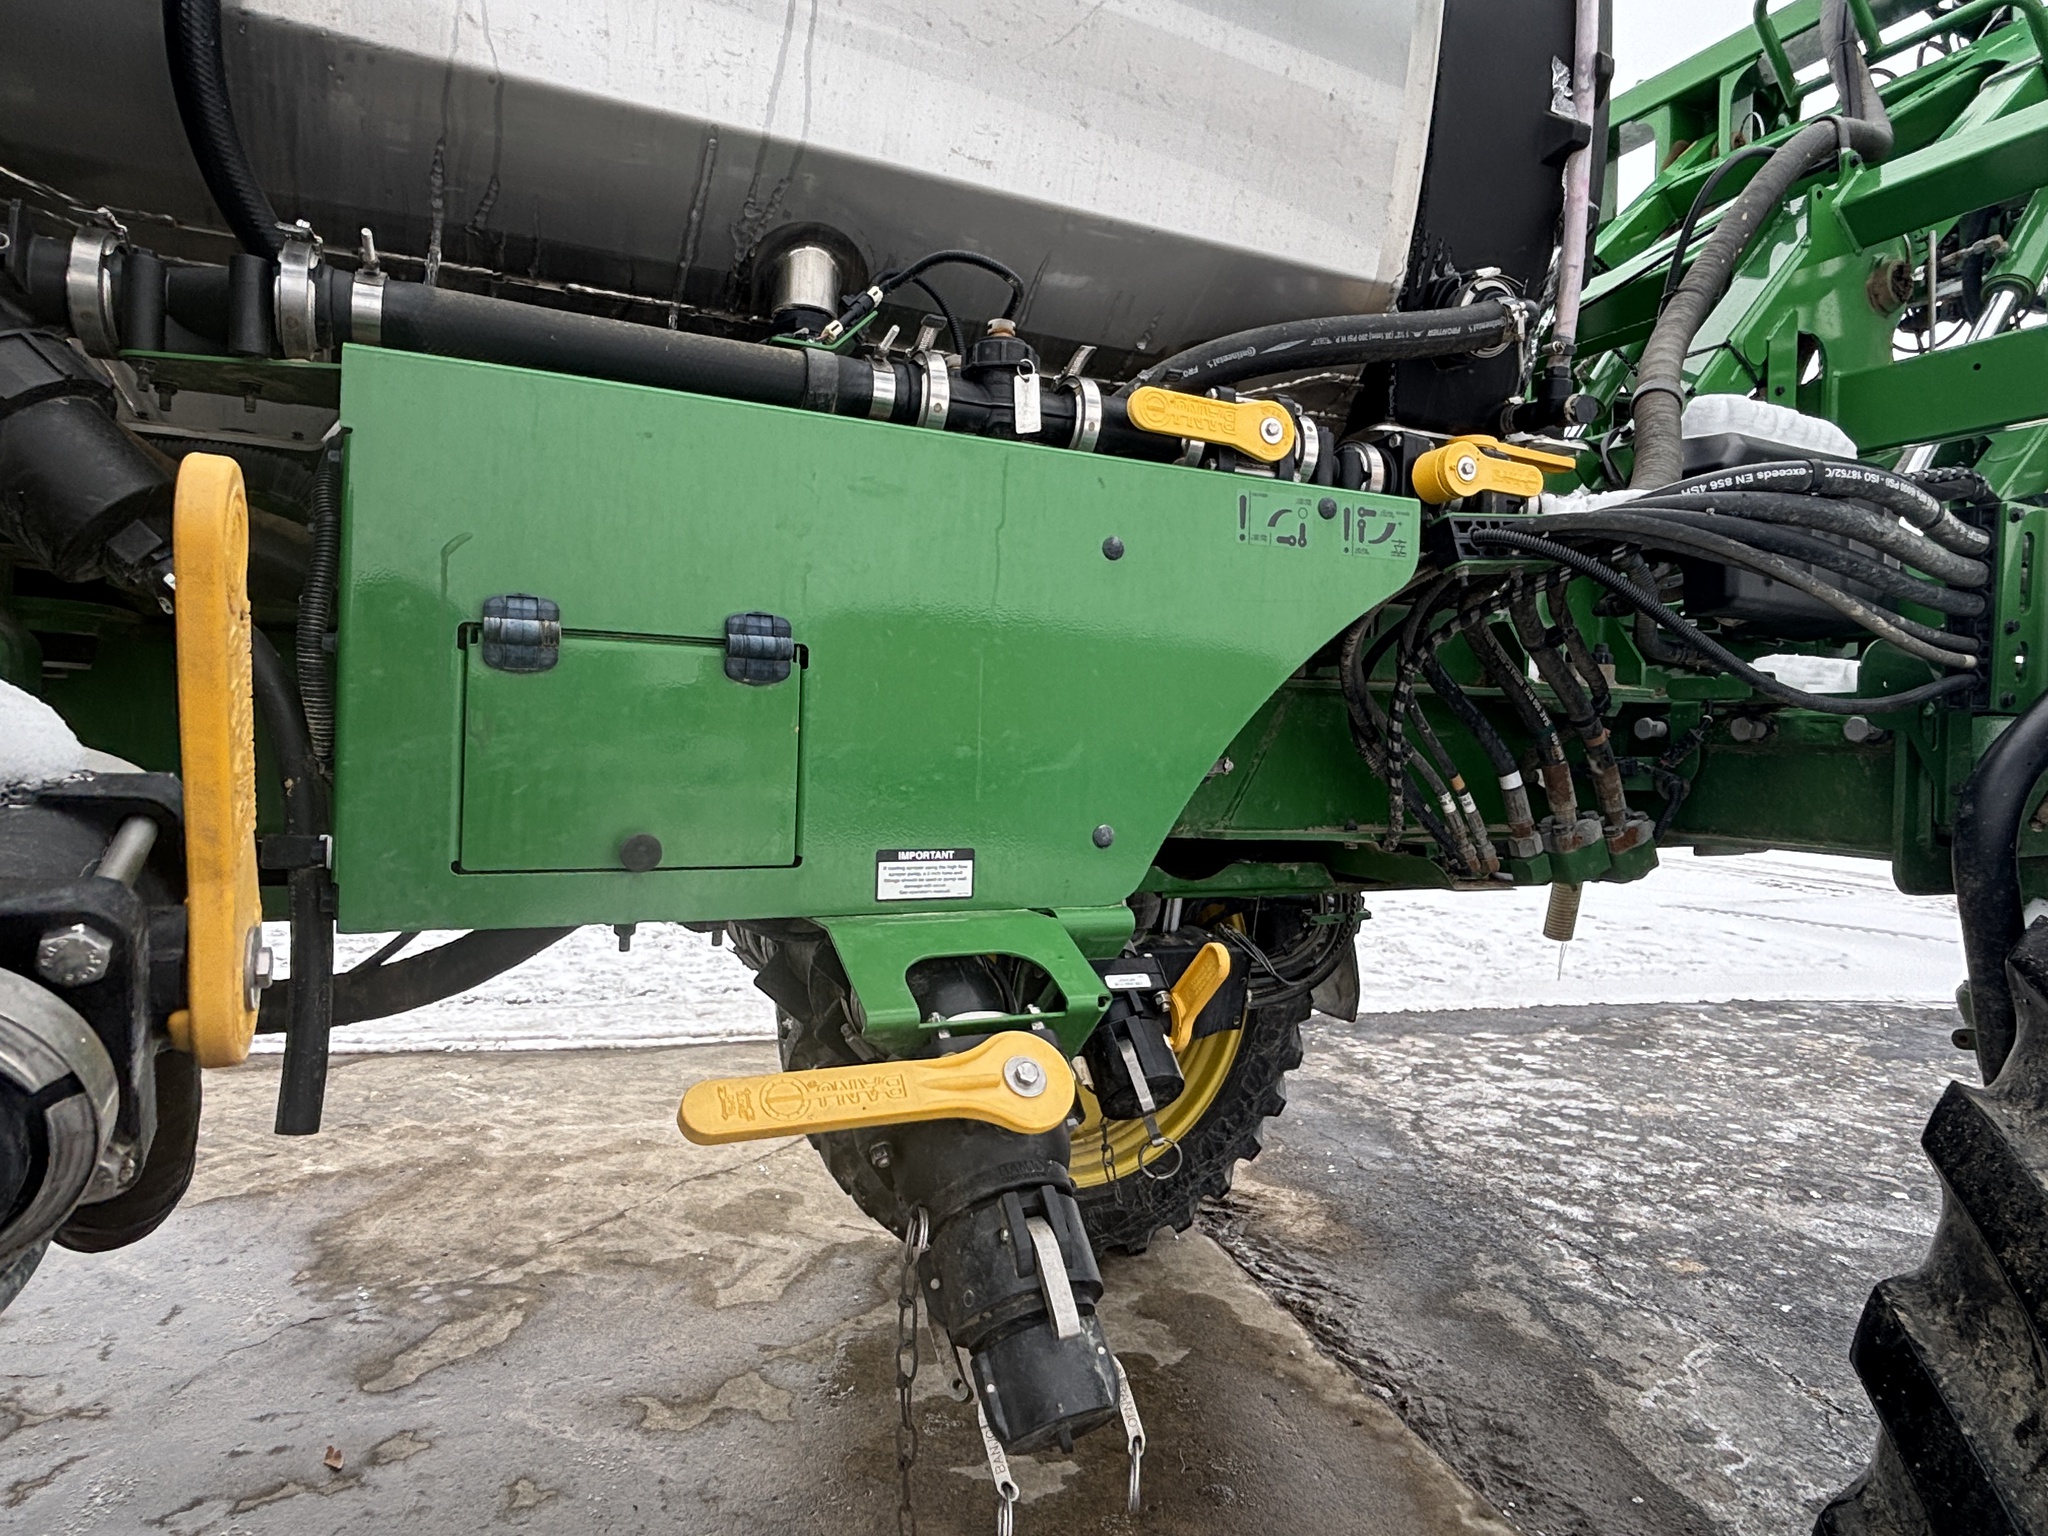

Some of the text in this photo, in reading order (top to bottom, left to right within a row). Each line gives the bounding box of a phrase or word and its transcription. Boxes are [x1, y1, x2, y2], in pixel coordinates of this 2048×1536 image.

[1213, 346, 1257, 367] Continental
[1735, 473, 1754, 486] EN
[1757, 467, 1807, 480] exceeds
[1825, 467, 1862, 479] 18752/C
[1864, 472, 1880, 484] ISO
[1709, 477, 1733, 491] 856
[898, 850, 955, 860] IMPORTANT
[985, 1429, 1007, 1475] BANJO
